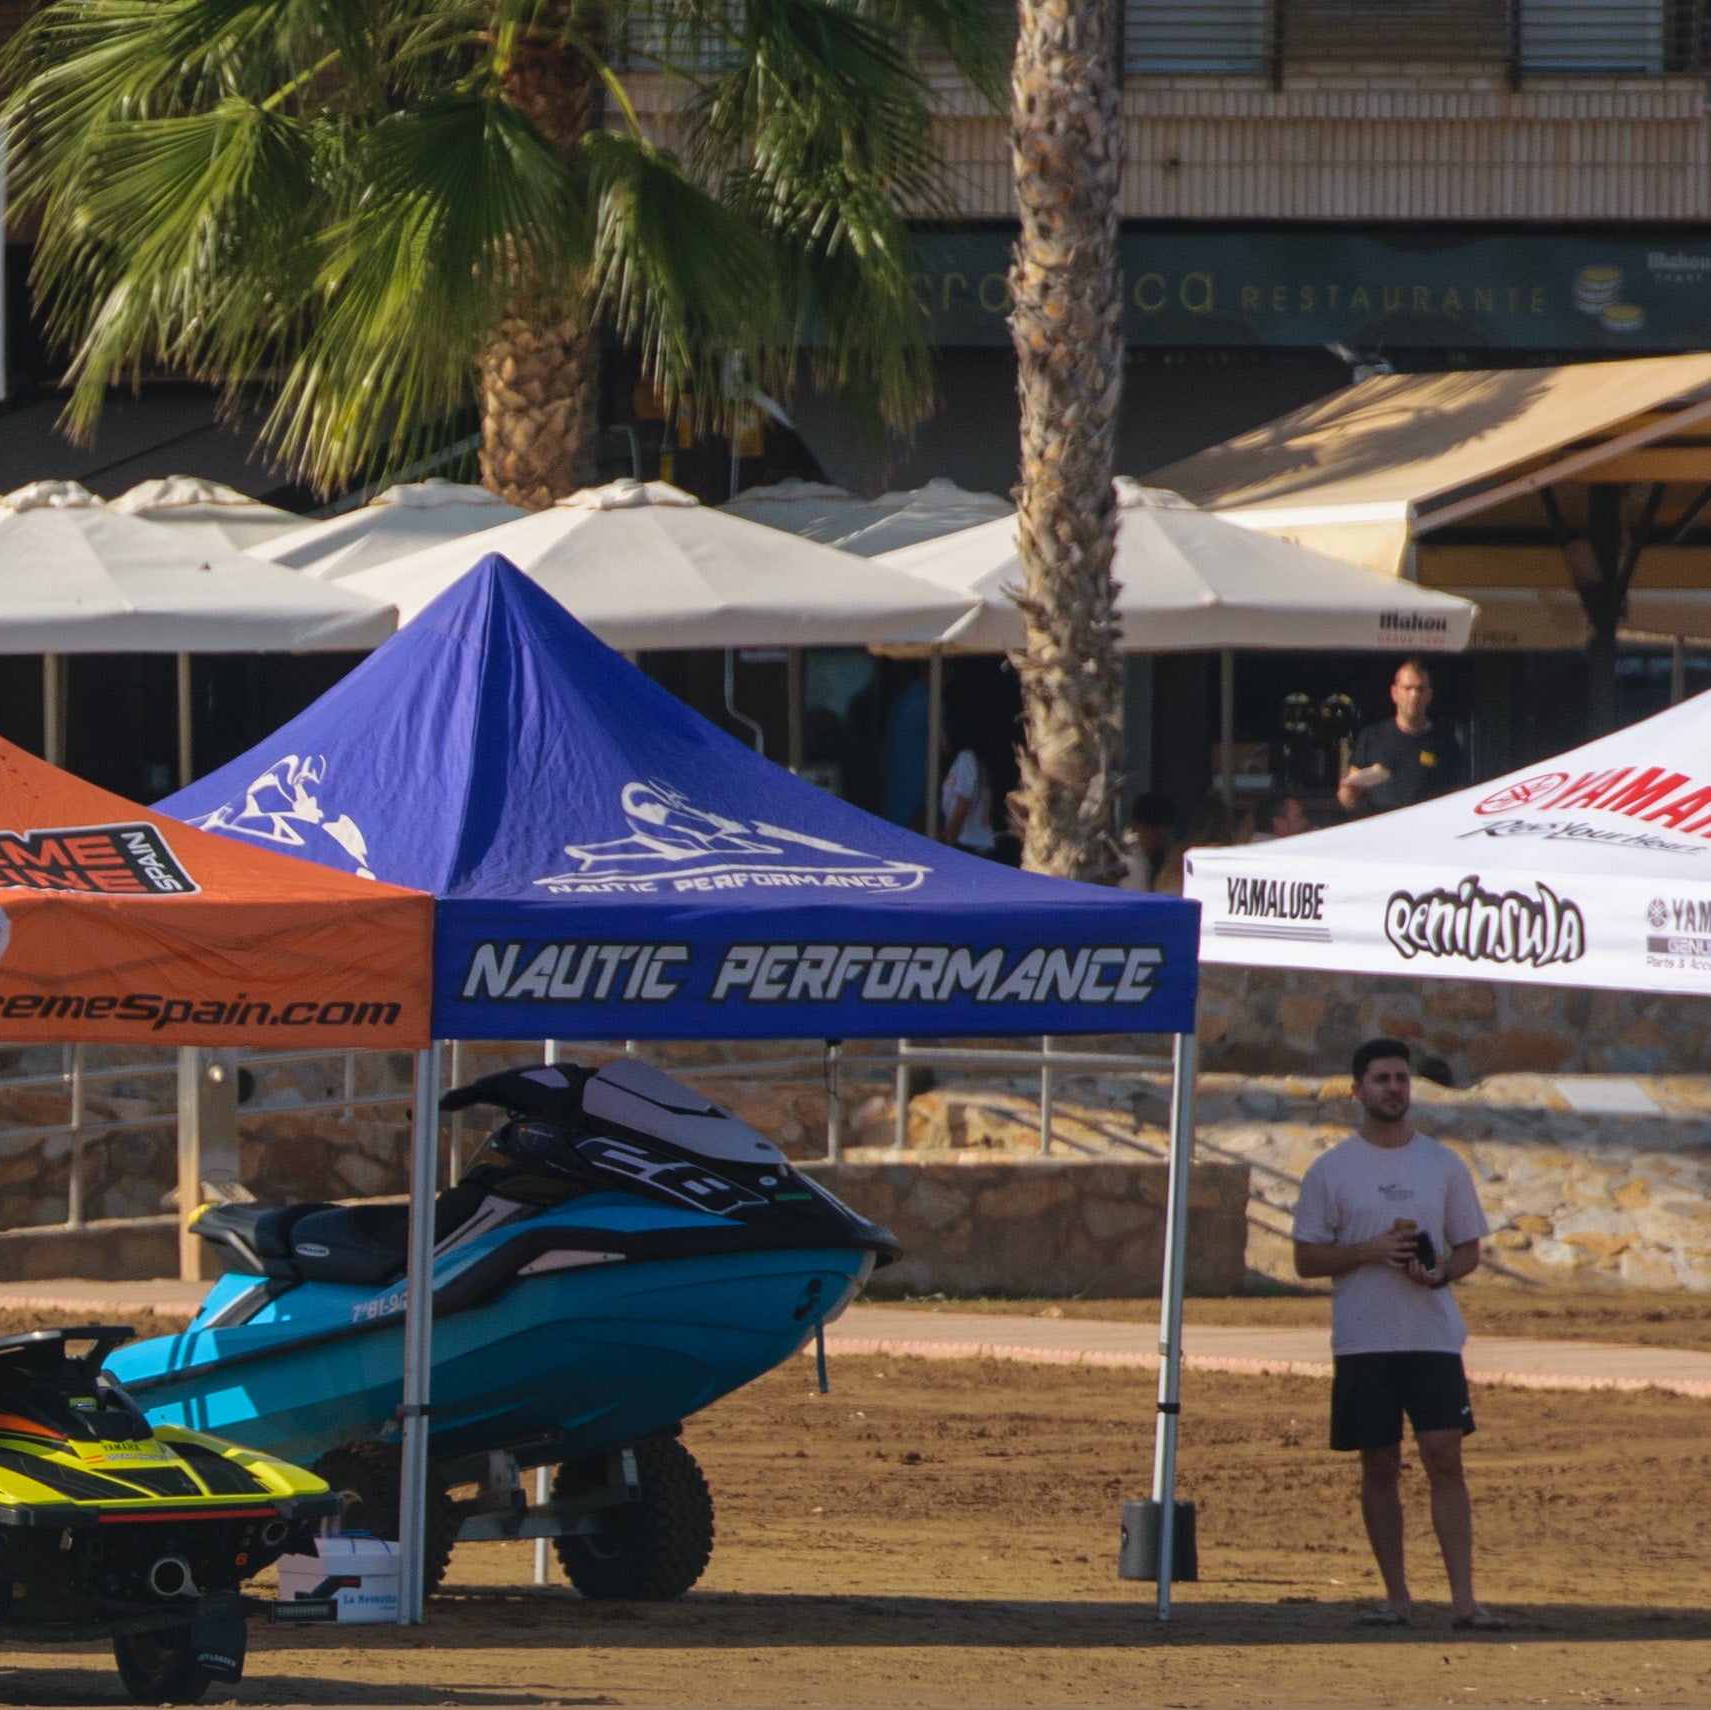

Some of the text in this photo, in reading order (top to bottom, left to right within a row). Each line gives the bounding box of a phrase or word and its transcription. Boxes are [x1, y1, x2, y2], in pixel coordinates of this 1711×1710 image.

[1239, 284, 1548, 314] RESTAURANTE
[119, 830, 184, 893] SPAIN
[547, 870, 904, 896] NAUTIC PERFORMANCE
[1226, 877, 1325, 921] YAMALUBE
[462, 944, 1164, 1001] NAUTIC PERFORMANCE
